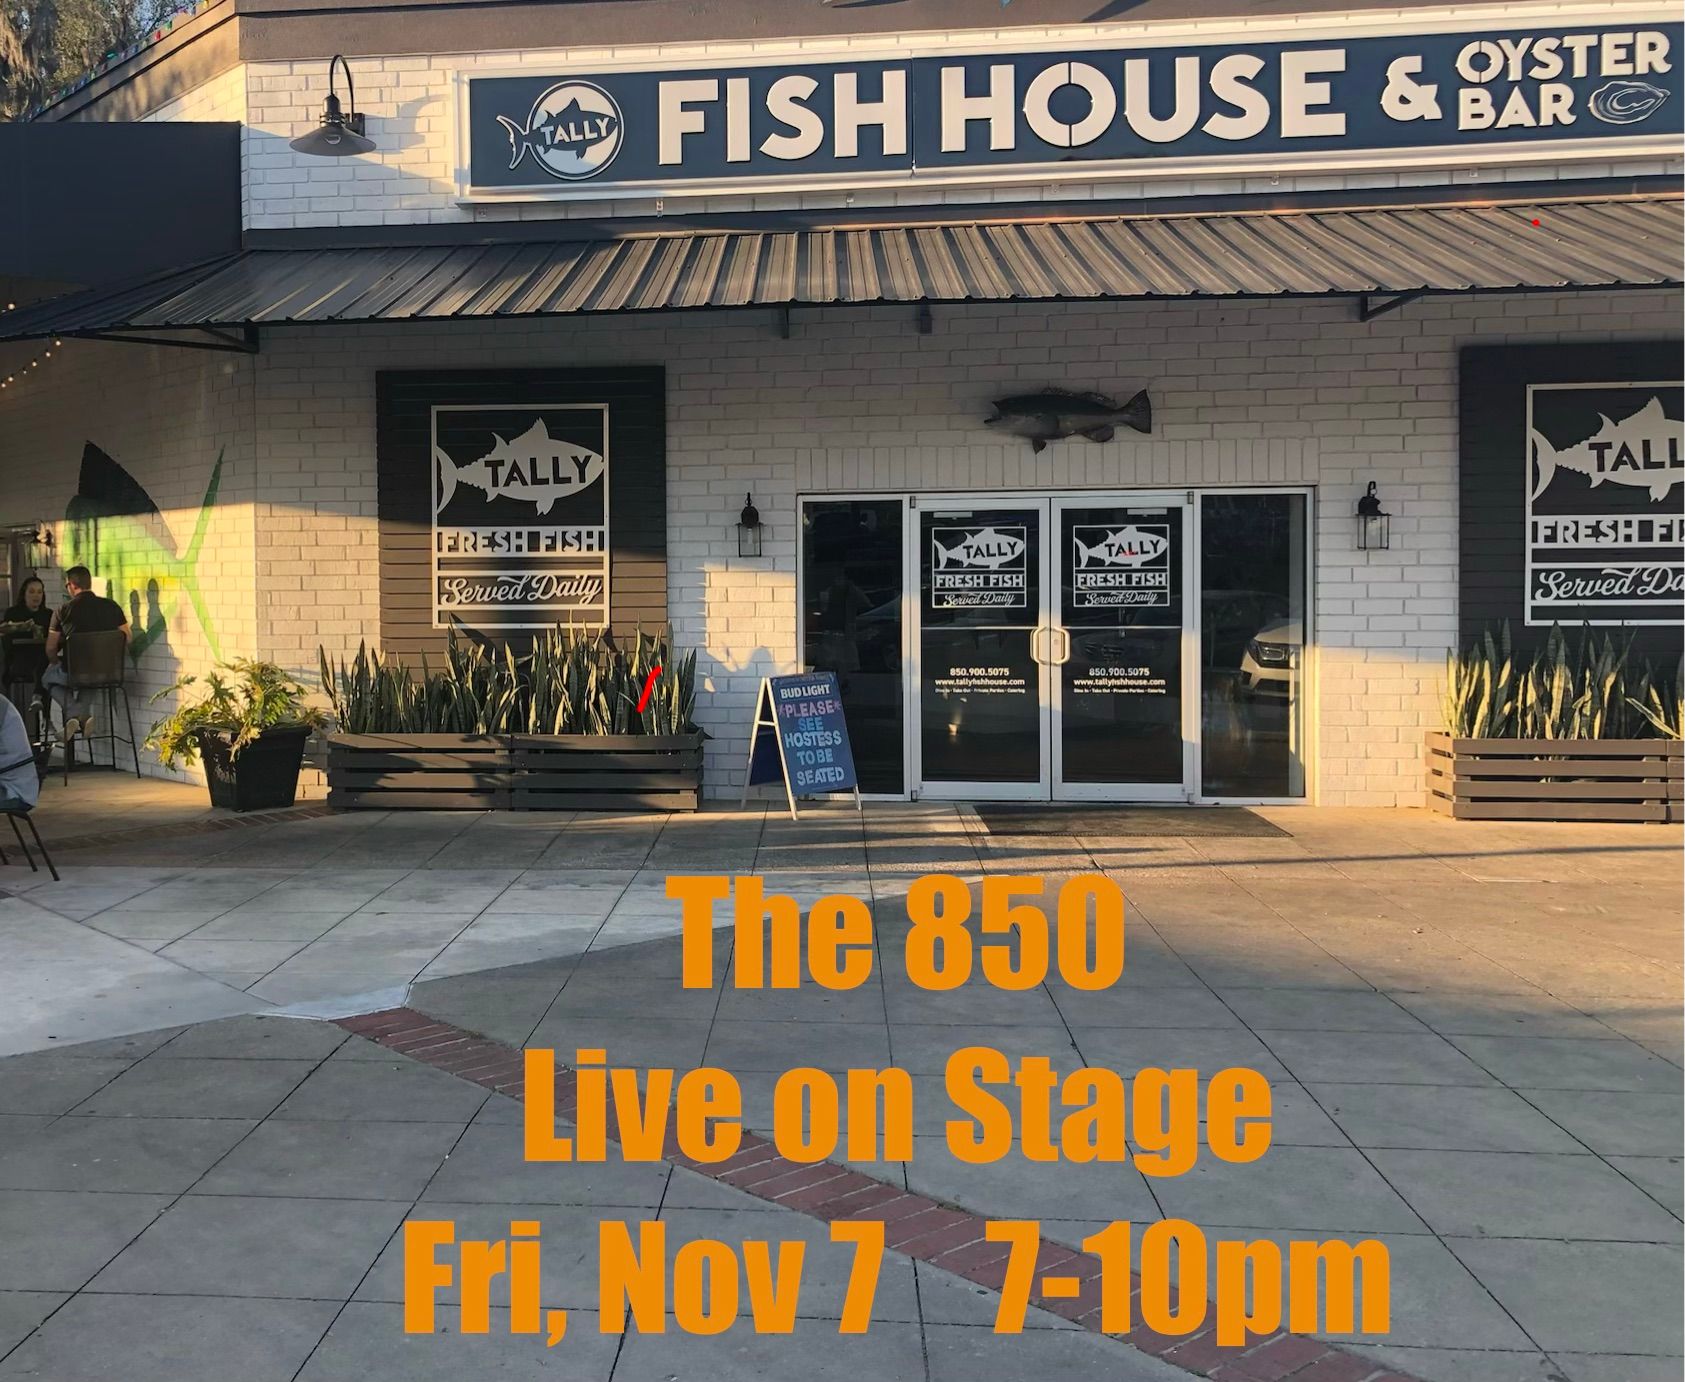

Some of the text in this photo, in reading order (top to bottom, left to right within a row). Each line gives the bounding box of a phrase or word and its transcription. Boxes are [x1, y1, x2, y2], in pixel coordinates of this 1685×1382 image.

[1455, 31, 1672, 84] OYSTER
[658, 49, 1442, 166] FISH HOUSE &
[1458, 83, 1577, 131] BAR
[540, 117, 610, 146] TALLY
[484, 455, 592, 488] TALLY
[1537, 519, 1640, 544] FRESH
[442, 530, 600, 553] FRESH FISH
[962, 541, 1018, 560] TALLY
[1104, 538, 1161, 558] TALLY
[936, 574, 1023, 588] FRESH FISH
[1077, 573, 1166, 587] FRESH FISH
[1534, 566, 1641, 601] Served
[440, 574, 602, 607] Served Daily
[943, 592, 1015, 607] Served Daily
[1085, 590, 1158, 606] Served Daily
[949, 667, 1010, 676] 850.900.5075
[1088, 667, 1150, 676] 850.900.5075
[780, 684, 830, 699] BUD LIGHT
[798, 716, 824, 731] SEE
[784, 730, 842, 748] HOSTESS
[796, 748, 834, 766] TO BE
[796, 767, 845, 786] SEATED
